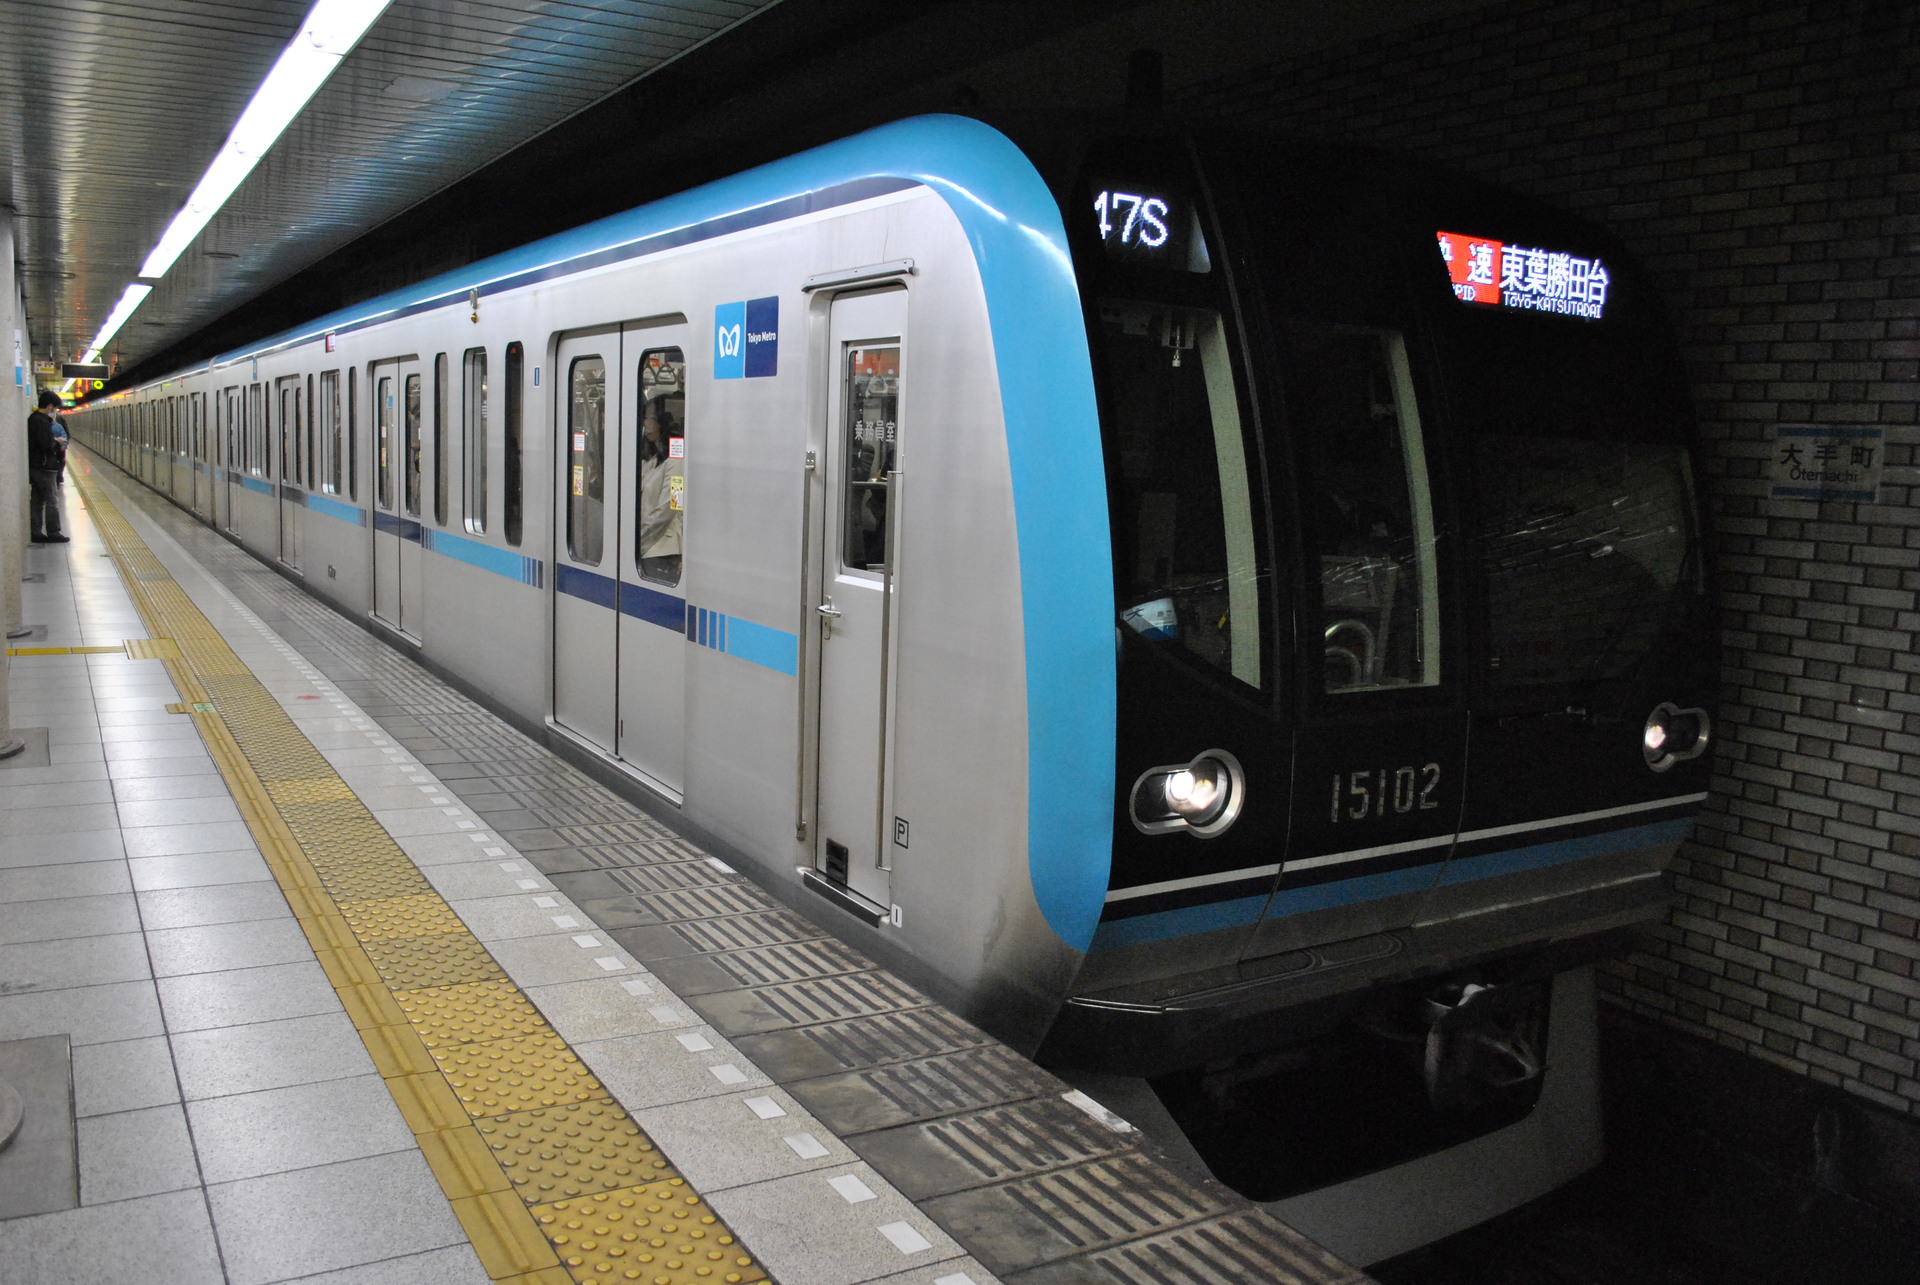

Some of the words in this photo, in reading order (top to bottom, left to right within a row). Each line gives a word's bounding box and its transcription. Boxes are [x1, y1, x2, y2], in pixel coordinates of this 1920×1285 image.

[1499, 243, 1609, 305] 東葉勝田台
[748, 332, 762, 345] Tokyo
[762, 330, 777, 342] Metro
[854, 420, 895, 443] 乗務員室
[1780, 443, 1876, 469] 大手町
[1331, 763, 1440, 822] 15102
